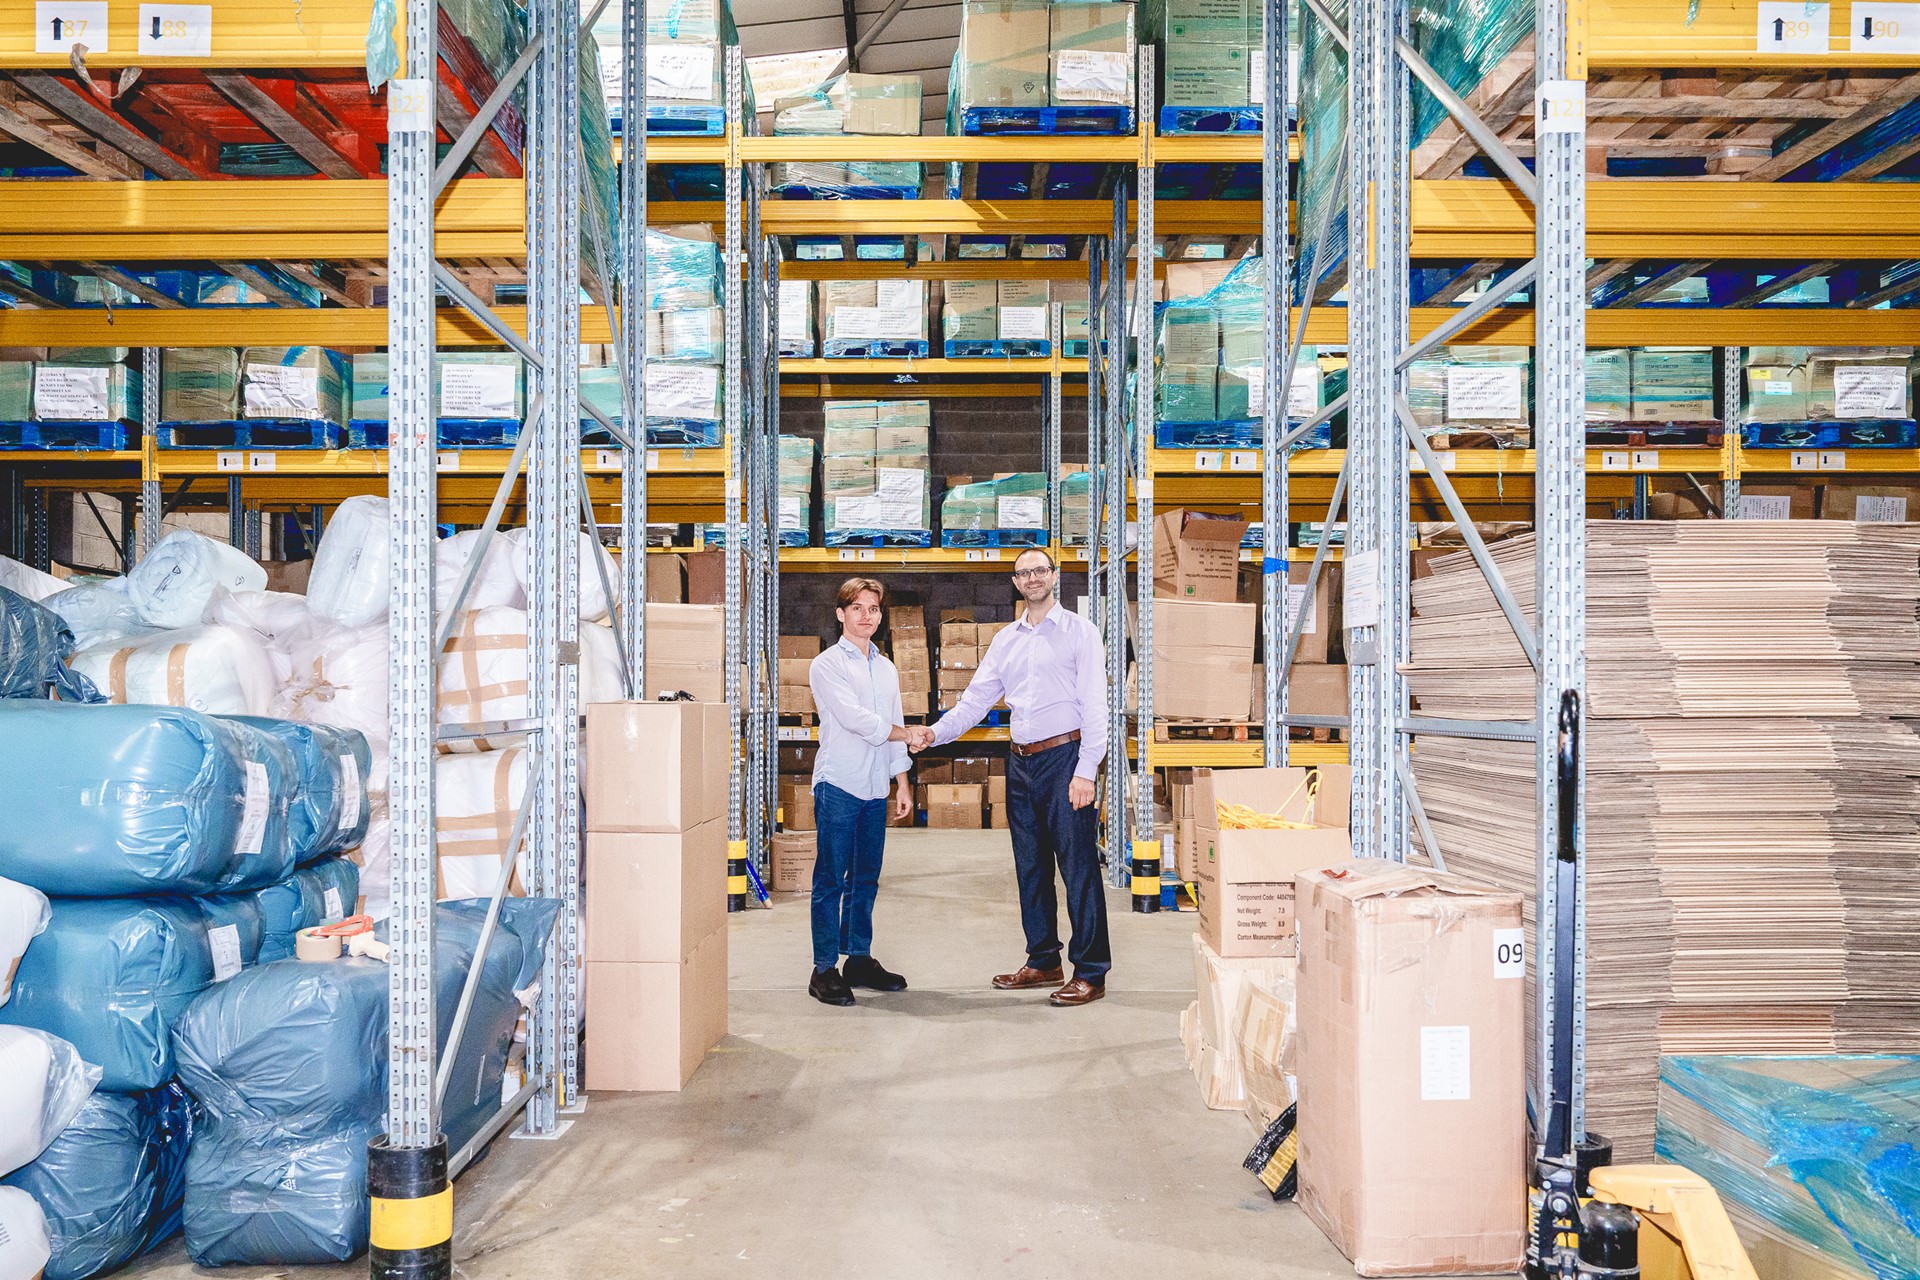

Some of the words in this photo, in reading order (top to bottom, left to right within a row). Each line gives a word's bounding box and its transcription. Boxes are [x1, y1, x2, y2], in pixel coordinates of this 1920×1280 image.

[63, 20, 88, 38] 87
[162, 20, 187, 38] 88
[1785, 21, 1809, 39] 89
[1874, 21, 1899, 39] 90
[392, 95, 425, 113] 122
[1551, 99, 1585, 117] 121
[1237, 894, 1262, 902] Component
[1251, 920, 1267, 928] Weight:
[1498, 943, 1522, 964] 09
